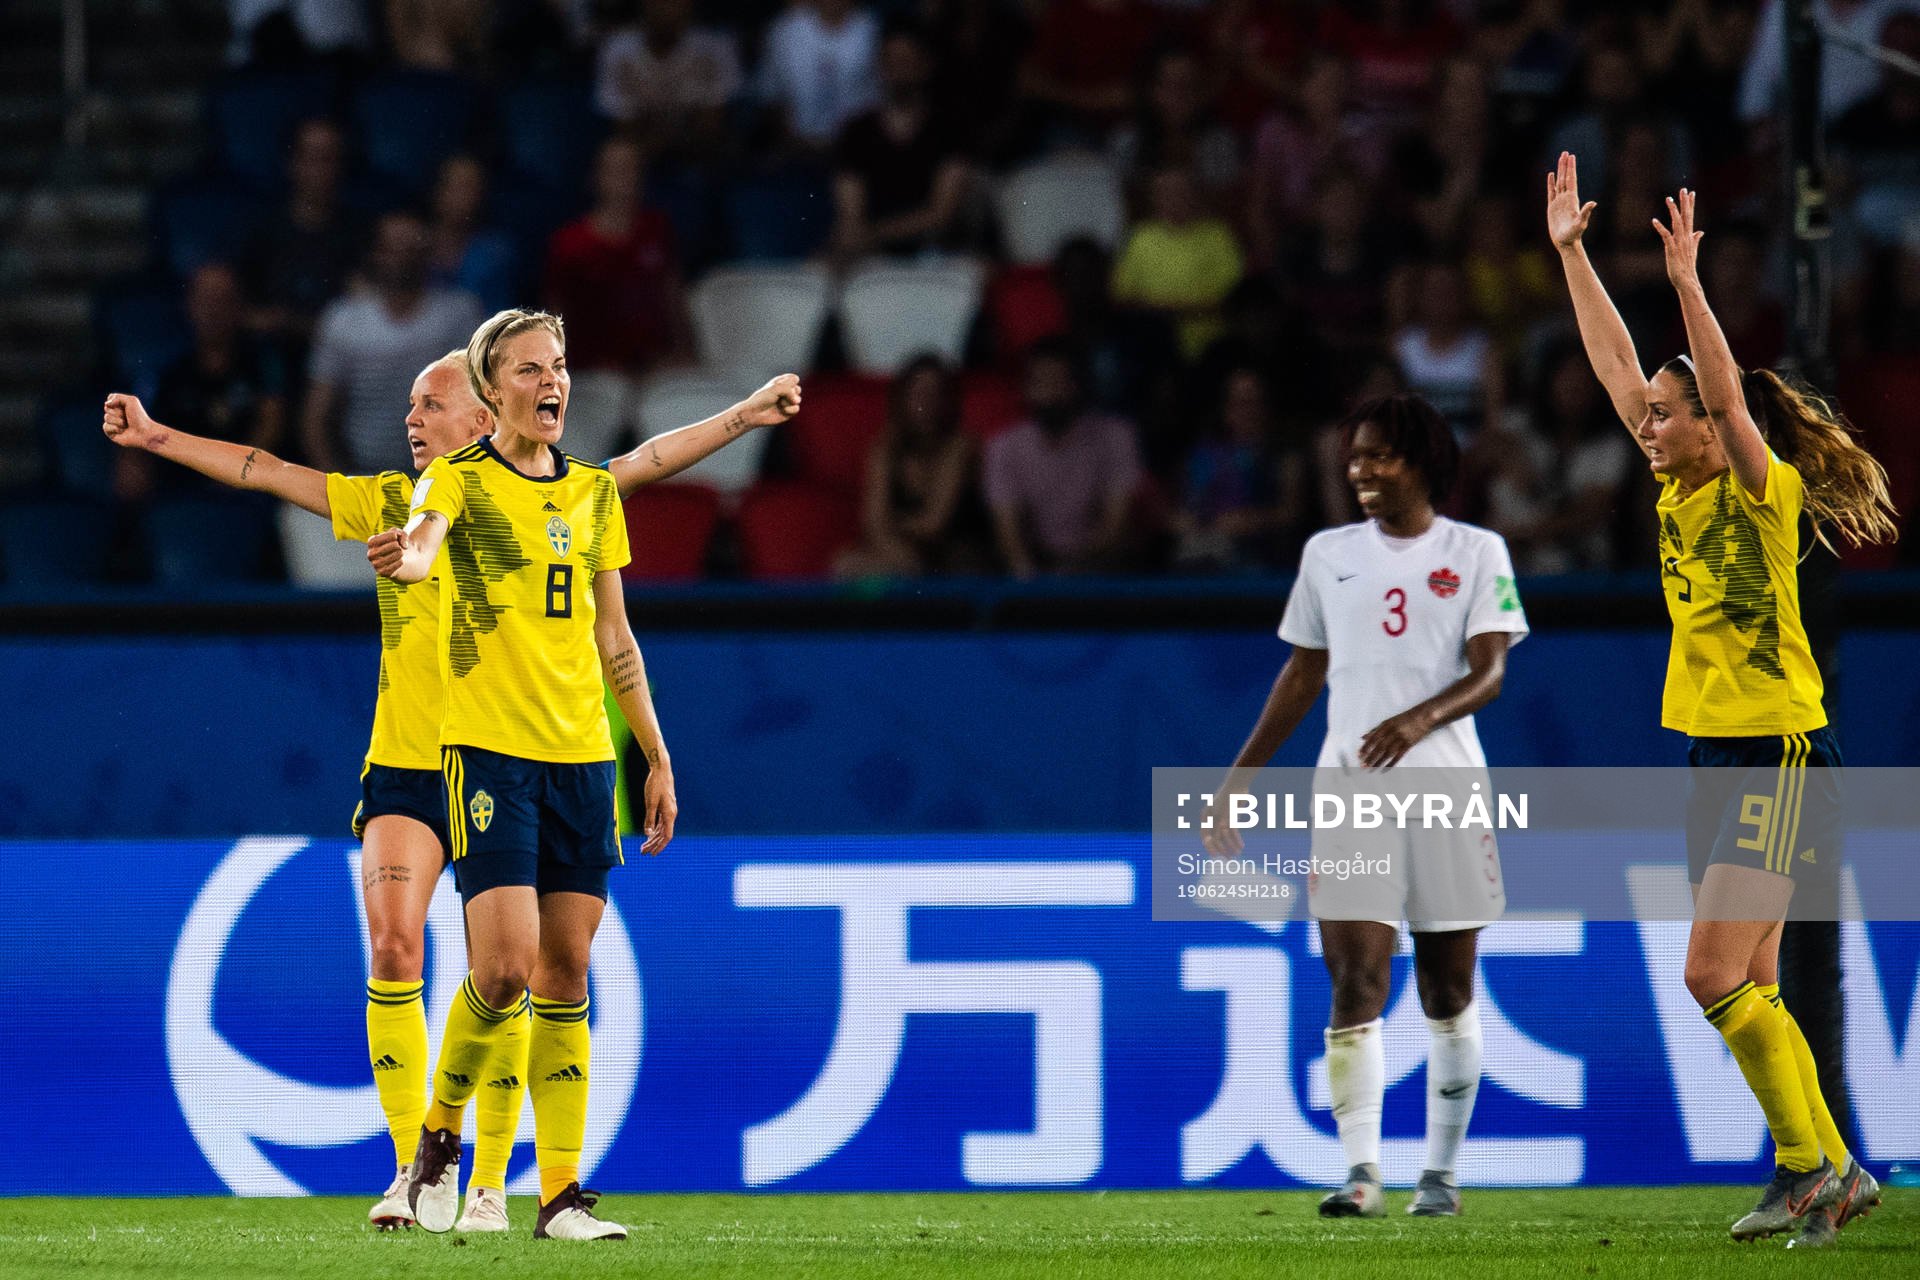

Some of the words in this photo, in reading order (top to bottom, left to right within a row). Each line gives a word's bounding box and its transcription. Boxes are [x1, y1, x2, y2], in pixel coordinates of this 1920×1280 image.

[545, 563, 573, 619] 8
[1382, 588, 1408, 638] 3
[1736, 794, 1774, 852] 9
